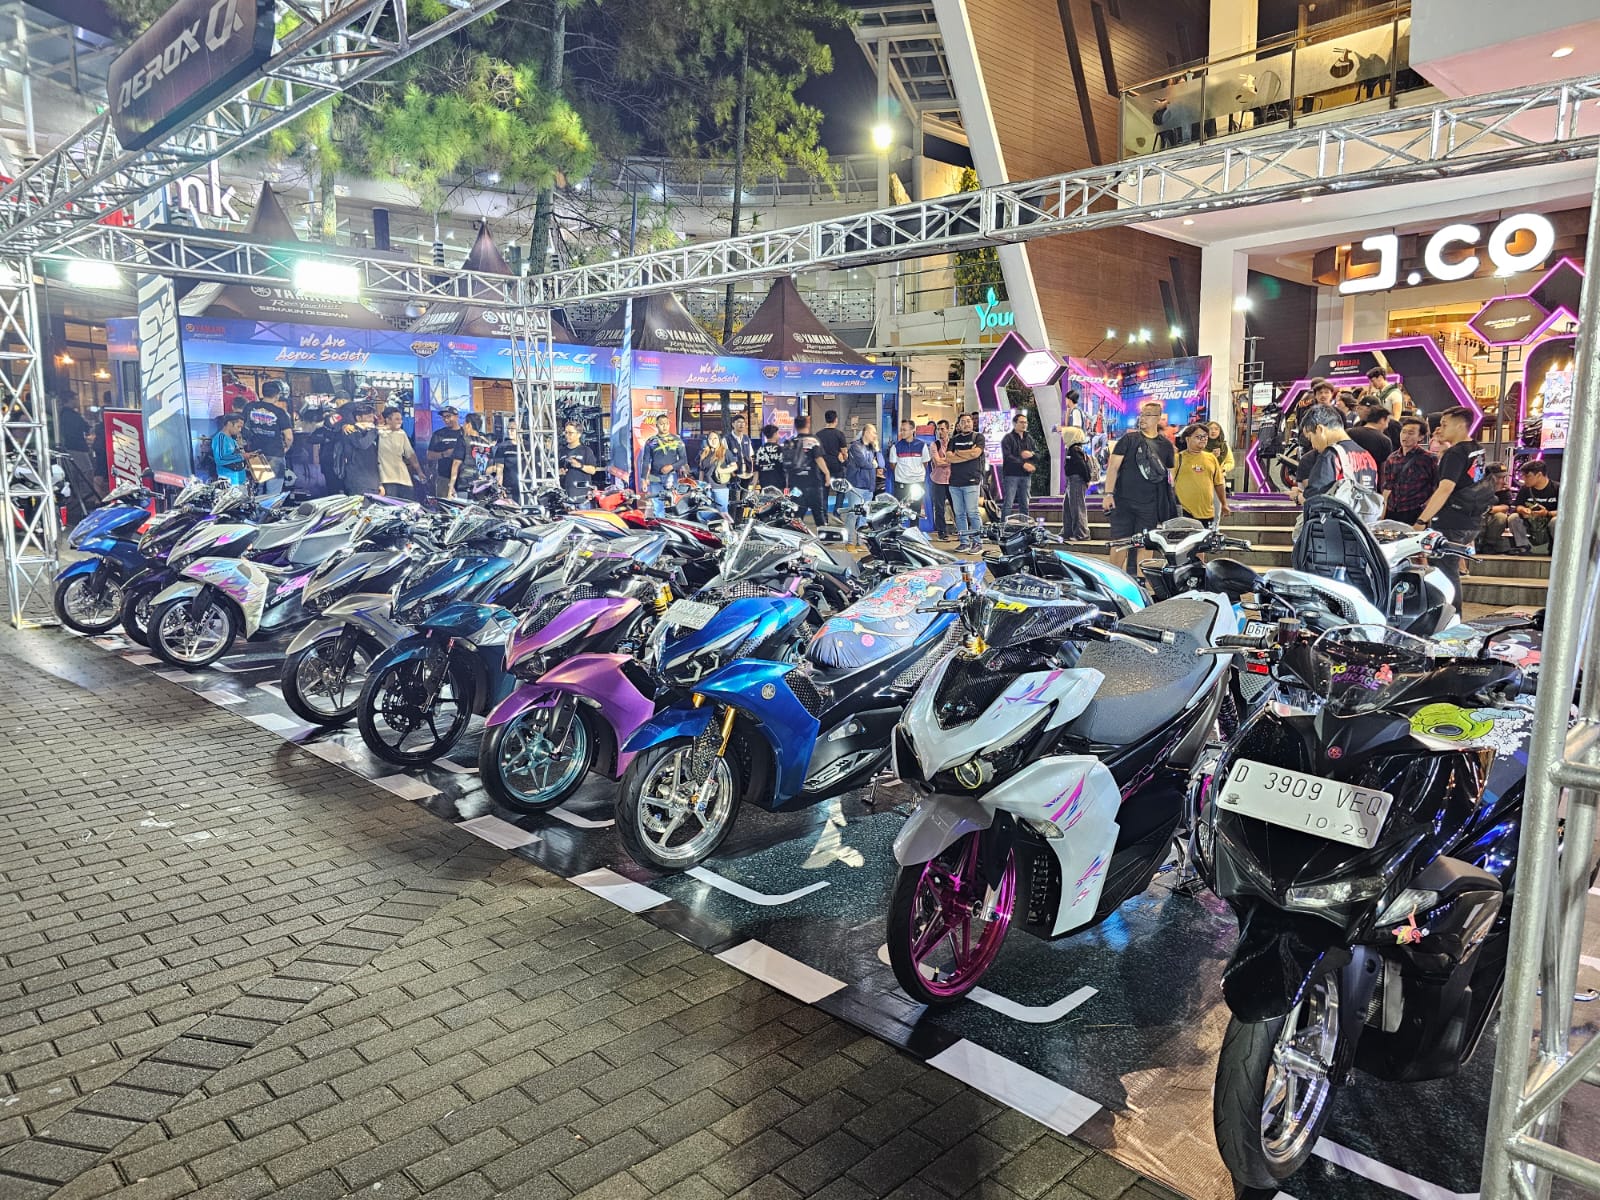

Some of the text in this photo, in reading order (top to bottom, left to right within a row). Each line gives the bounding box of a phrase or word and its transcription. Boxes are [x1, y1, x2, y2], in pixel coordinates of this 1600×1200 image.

[117, 19, 201, 114] AEROX
[300, 333, 346, 347] We Are
[668, 329, 707, 343] YAMAHA
[742, 334, 774, 345] YAMAHA
[804, 333, 838, 345] YAMAHA
[275, 347, 370, 366] Aerox Society
[700, 363, 726, 374] We Are
[813, 368, 858, 376] AEROX
[686, 374, 739, 384] Aerox Society
[1152, 390, 1182, 401] STAND
[1182, 389, 1200, 399] UP!
[1332, 672, 1379, 691] GARAGE
[1234, 764, 1383, 817] D 3909 VEQ
[1305, 812, 1369, 839] 10 29
